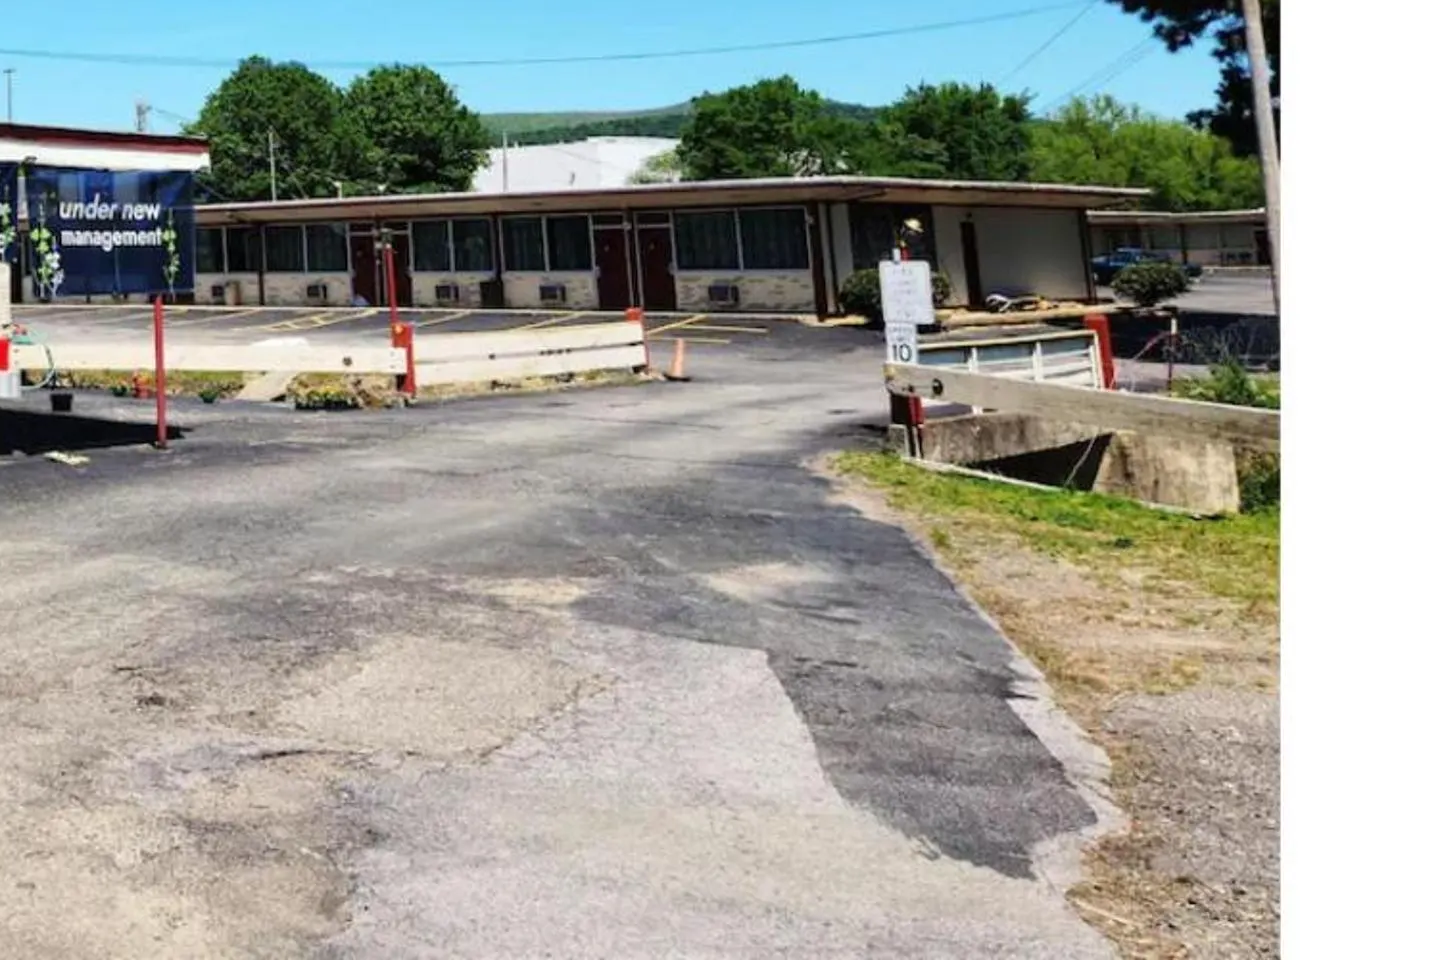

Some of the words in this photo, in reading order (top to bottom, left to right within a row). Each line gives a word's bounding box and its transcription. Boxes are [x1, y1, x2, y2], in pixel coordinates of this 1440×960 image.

[59, 192, 118, 220] under
[121, 202, 161, 220] new
[61, 227, 163, 252] management
[892, 343, 913, 363] 10
